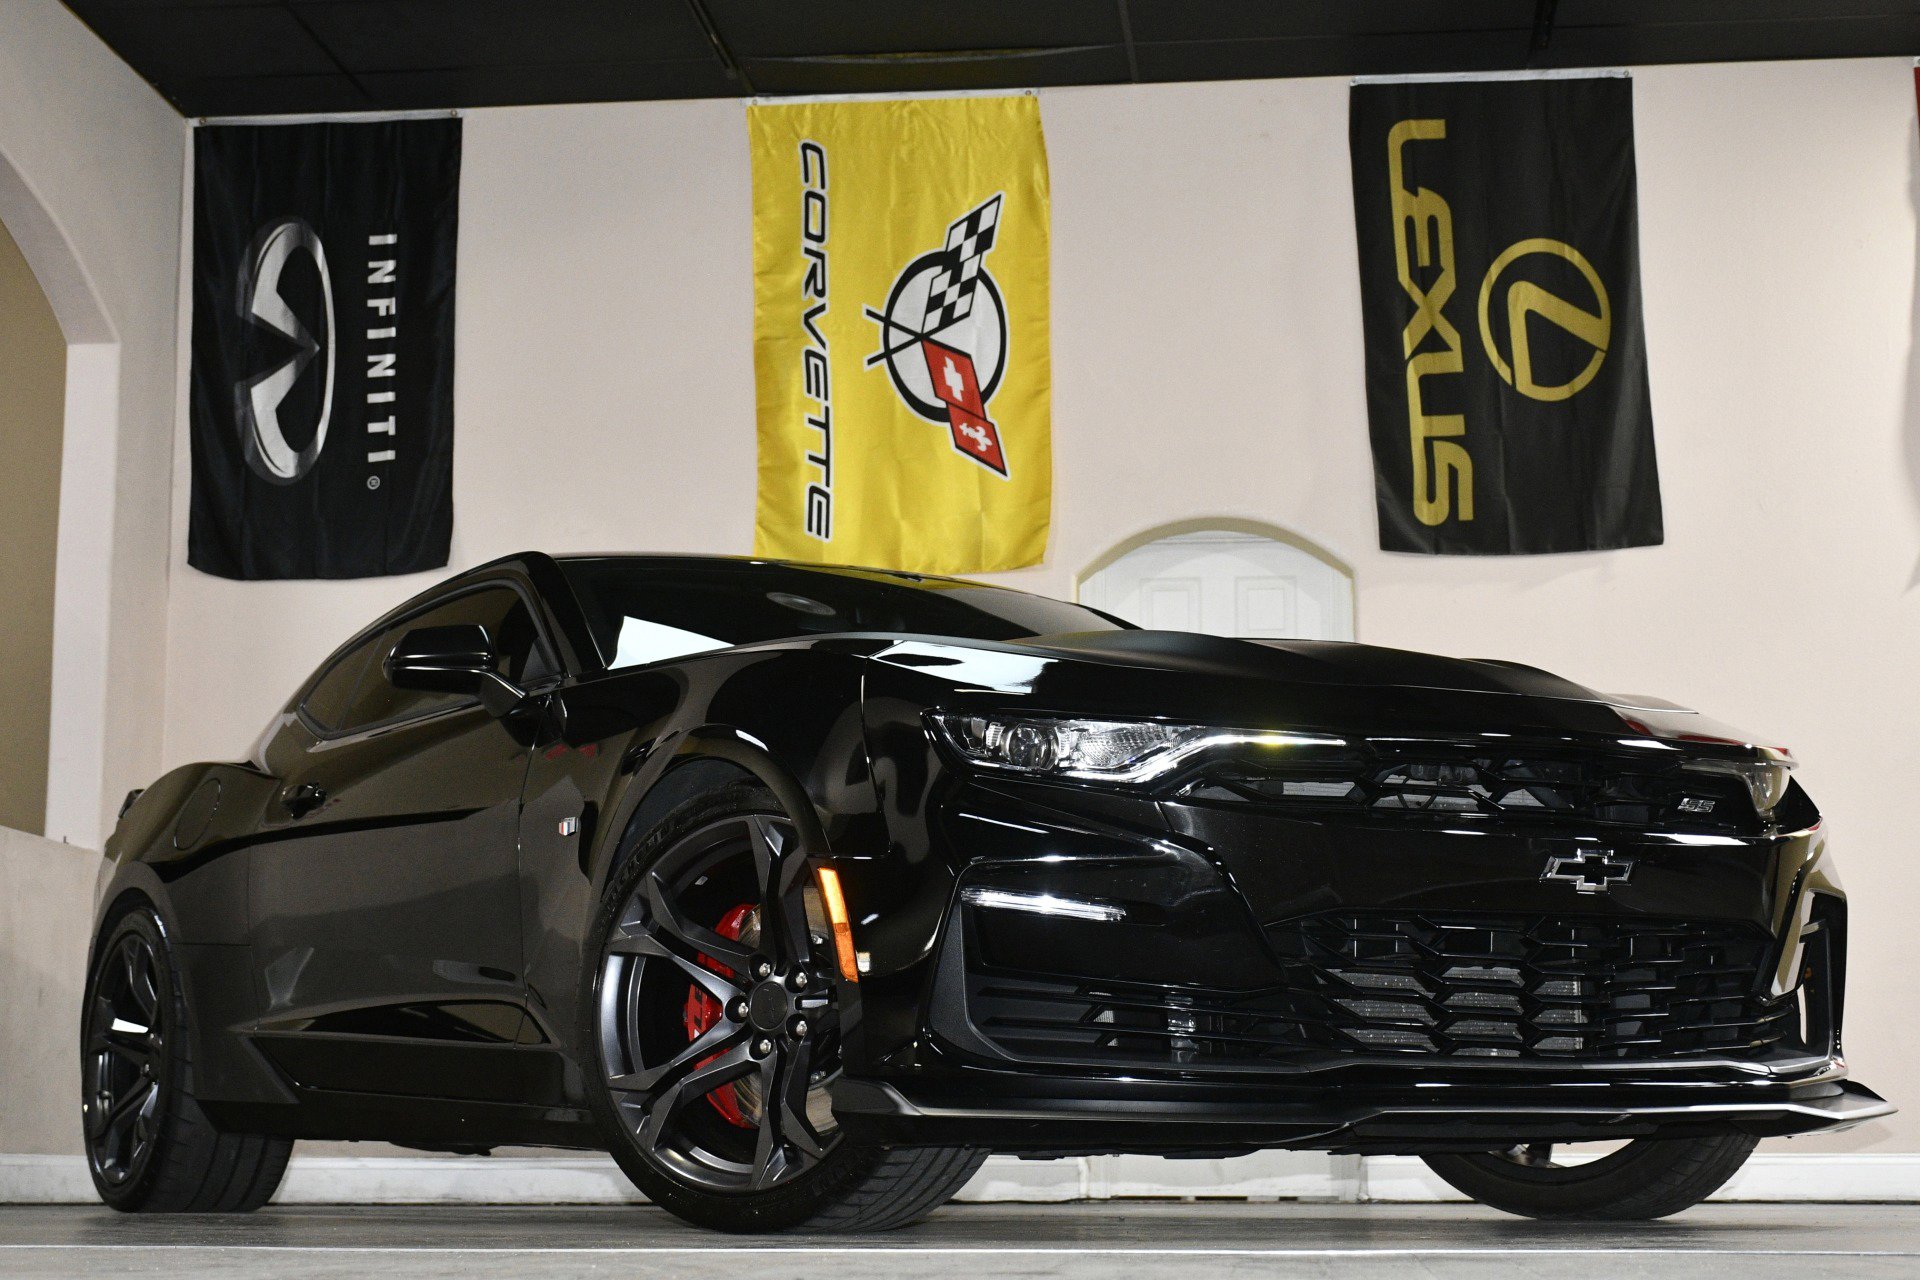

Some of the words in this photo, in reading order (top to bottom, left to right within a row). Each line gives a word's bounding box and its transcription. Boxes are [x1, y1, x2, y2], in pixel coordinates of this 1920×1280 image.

[366, 233, 398, 463] INFINITI
[801, 138, 832, 542] CORVETTE
[1387, 119, 1474, 526] LEXUS
